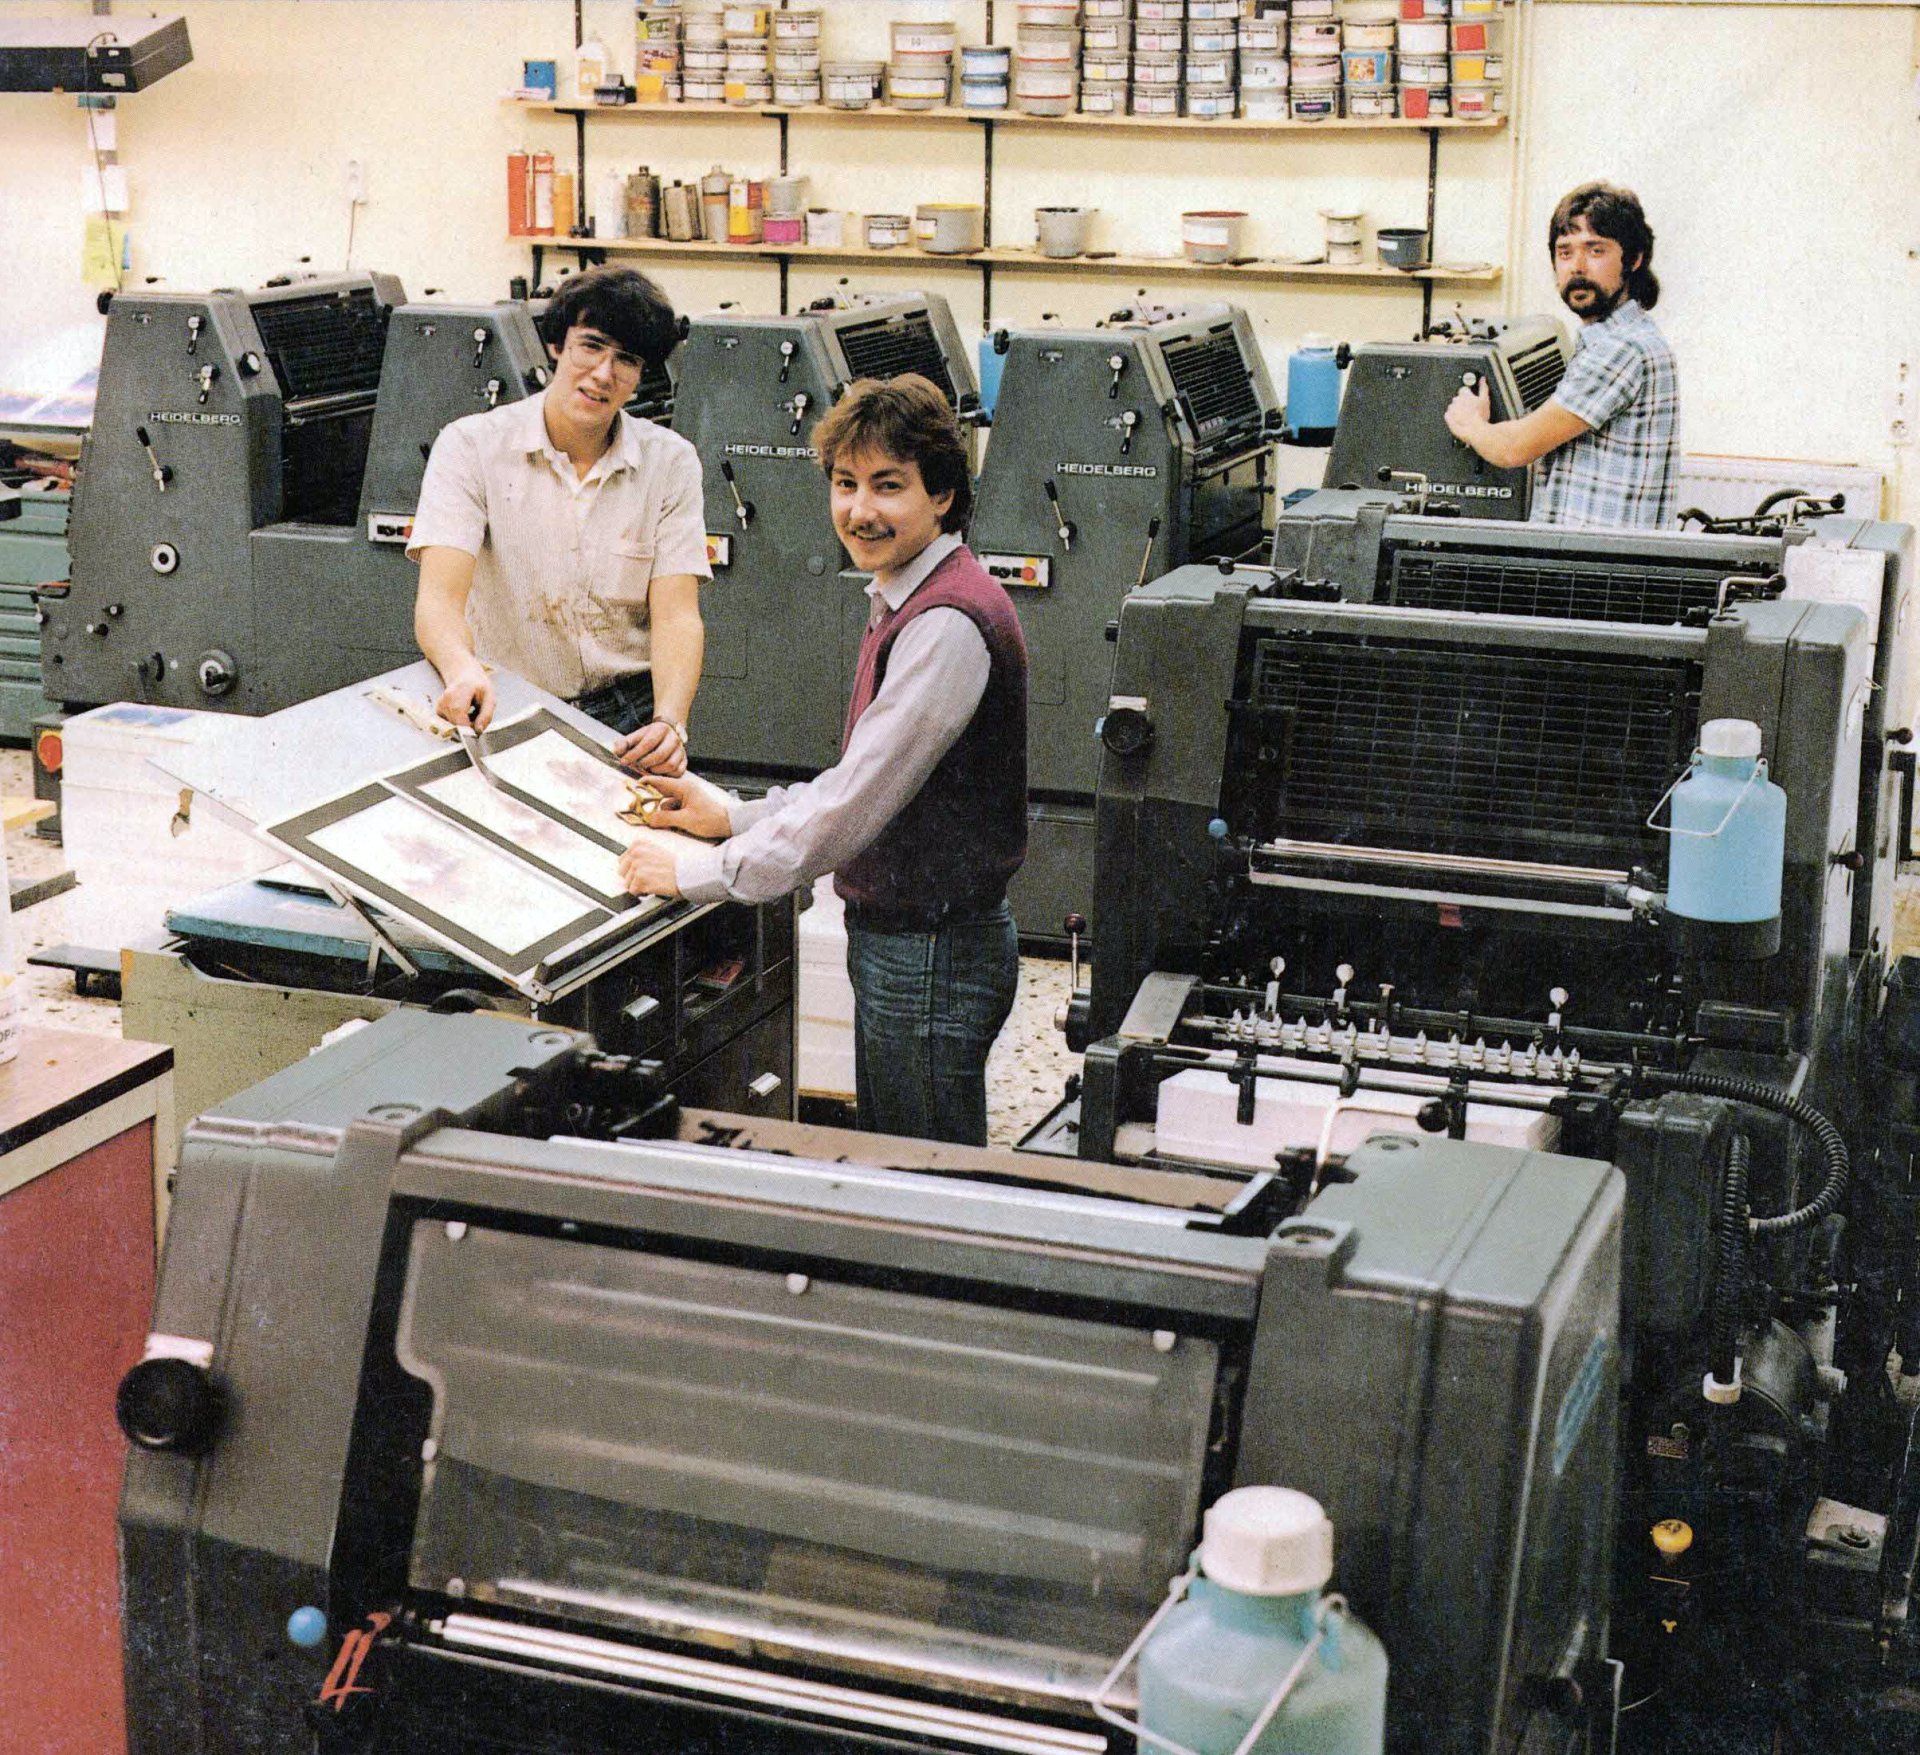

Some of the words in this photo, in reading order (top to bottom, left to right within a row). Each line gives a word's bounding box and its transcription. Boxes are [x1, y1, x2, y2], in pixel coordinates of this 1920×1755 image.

[150, 411, 241, 425] HEIDELBERG
[725, 444, 819, 458] HEIDELBERG
[1056, 462, 1157, 477] HEIDELBERG
